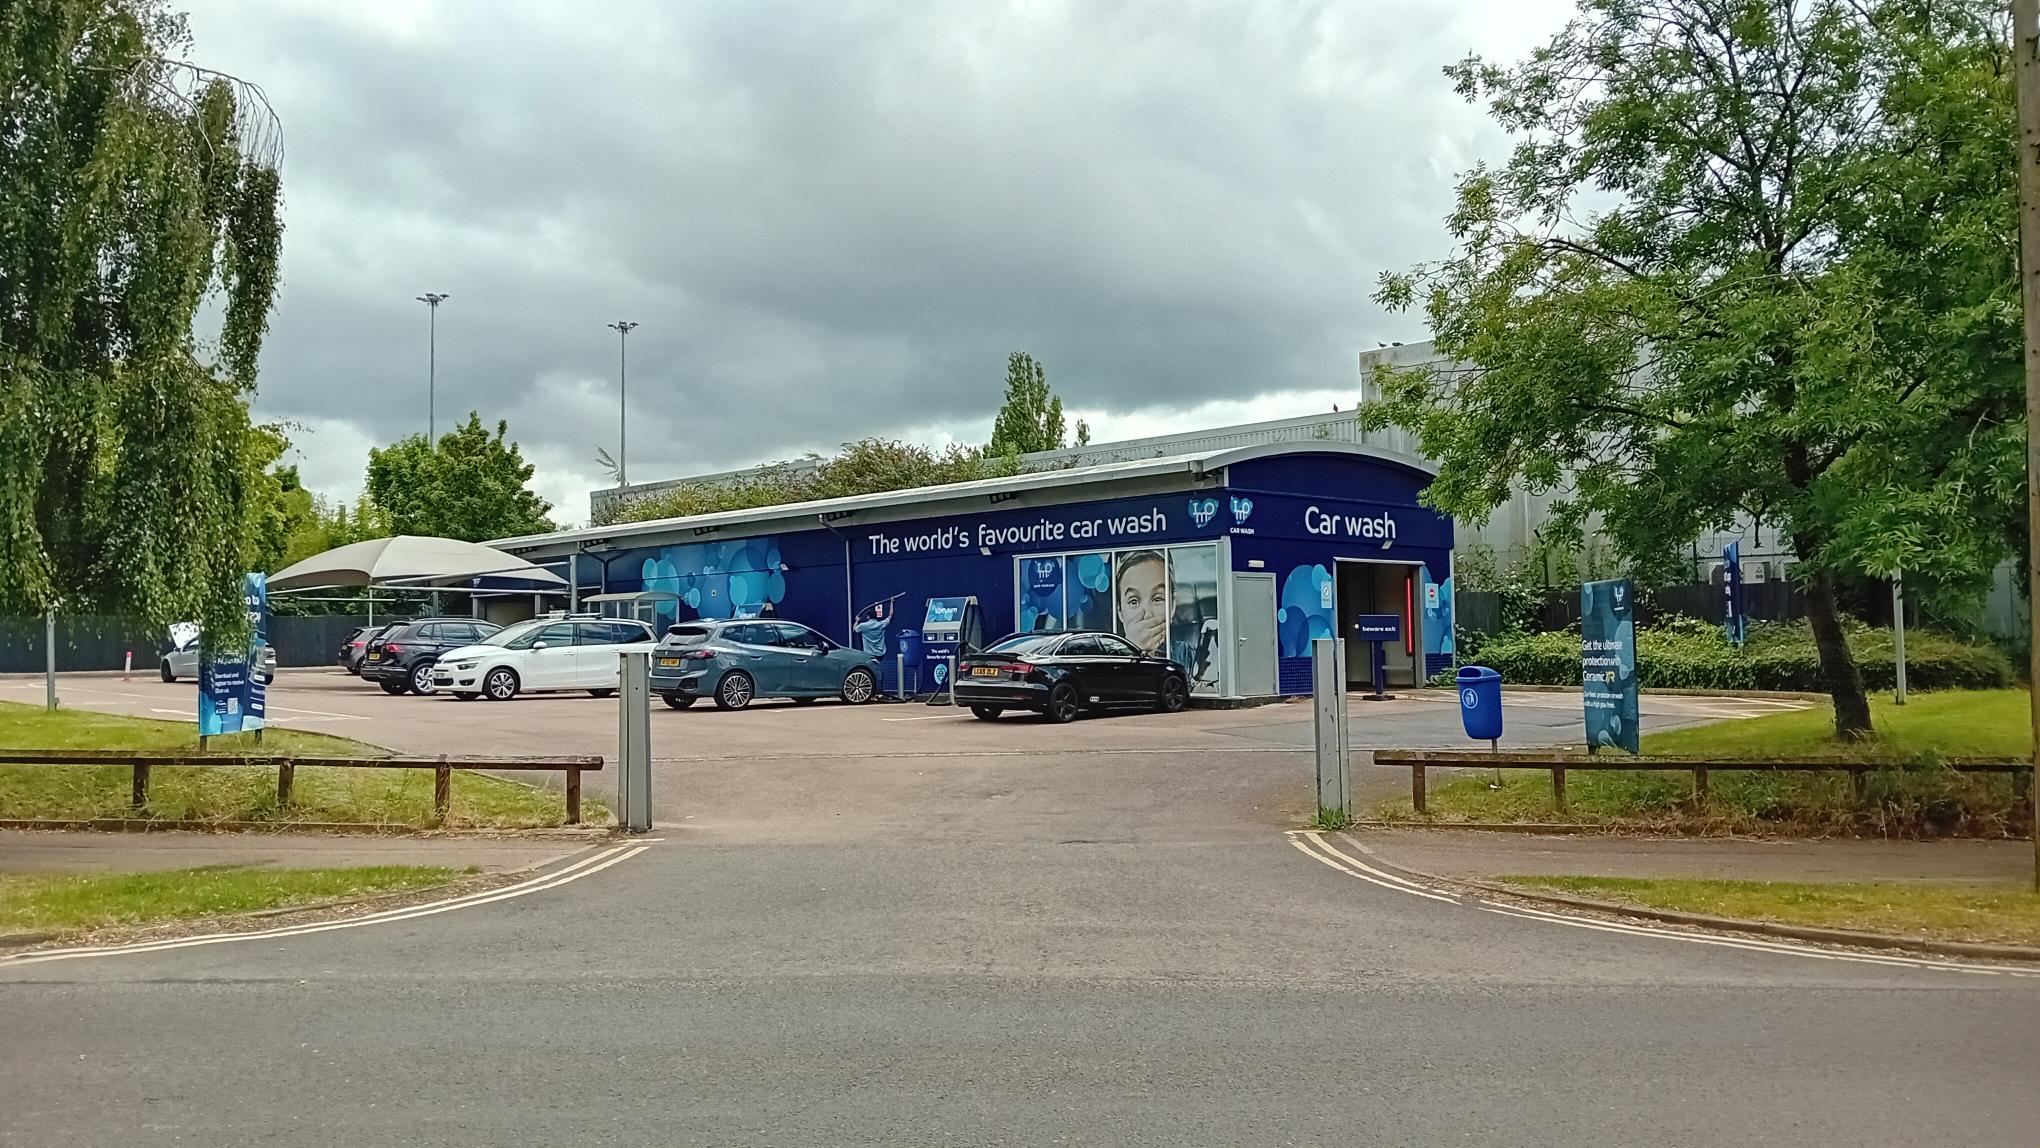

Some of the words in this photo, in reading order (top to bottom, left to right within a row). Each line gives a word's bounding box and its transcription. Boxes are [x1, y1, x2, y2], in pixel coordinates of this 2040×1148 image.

[1304, 505, 1341, 535] Car
[1345, 511, 1397, 539] wash
[869, 534, 900, 555] The
[904, 526, 970, 552] world's
[978, 518, 1064, 547] favourite
[1070, 519, 1102, 539] car
[1107, 507, 1167, 535] wash
[1582, 640, 1592, 651] Get
[1592, 639, 1602, 651] the
[1603, 639, 1622, 650] ultimate
[1582, 655, 1610, 668] protection
[1611, 655, 1621, 666] with
[1583, 671, 1605, 682] Ceramic
